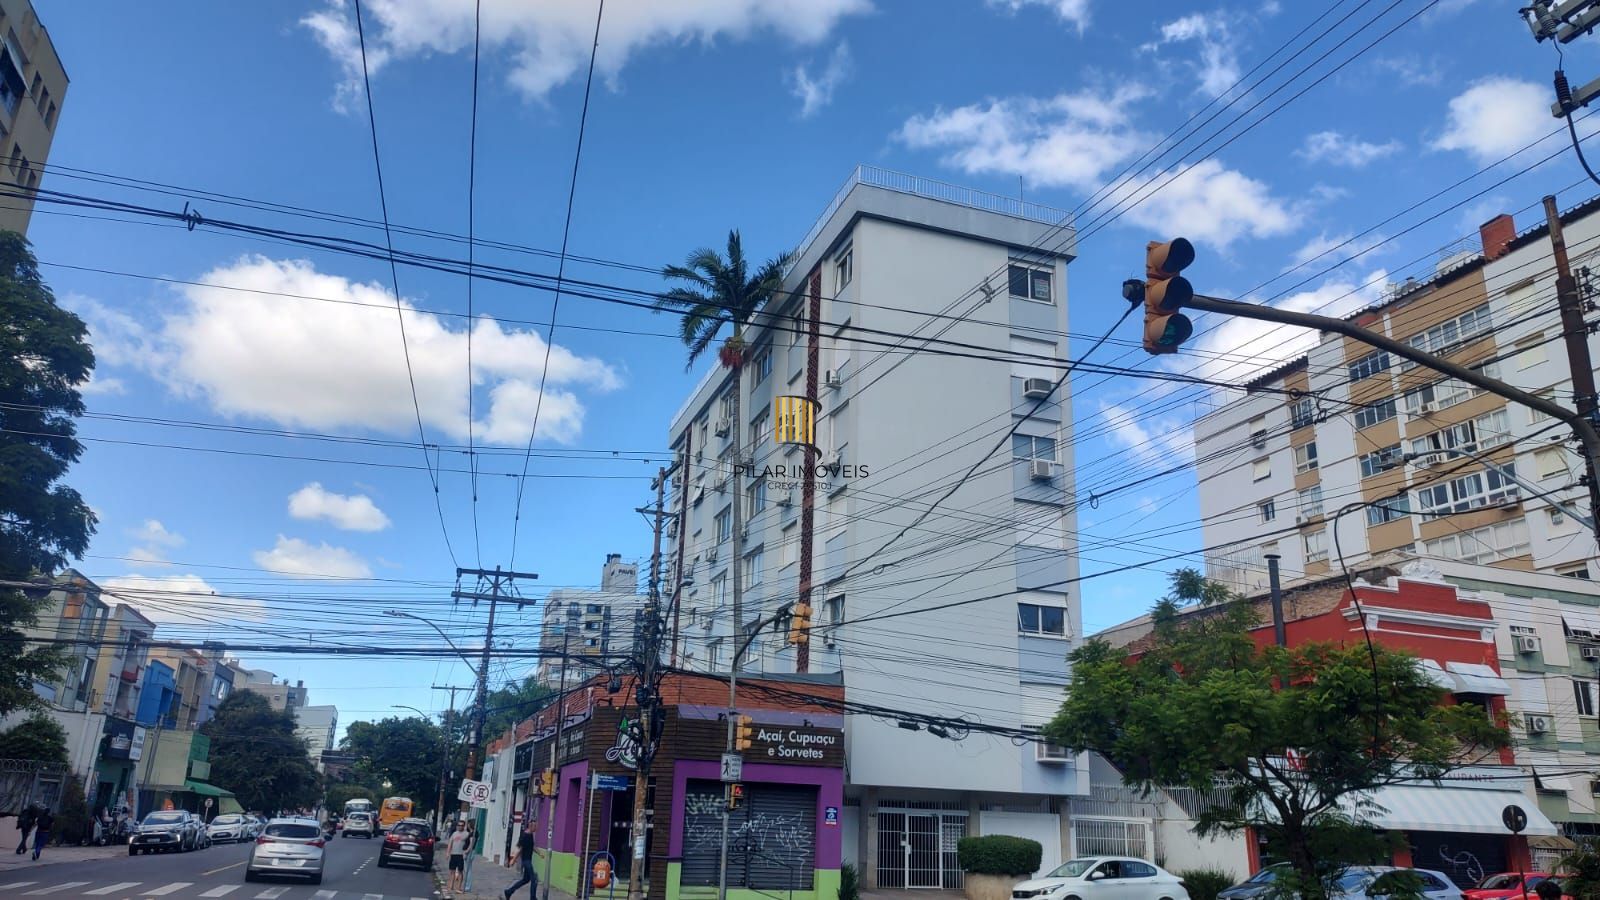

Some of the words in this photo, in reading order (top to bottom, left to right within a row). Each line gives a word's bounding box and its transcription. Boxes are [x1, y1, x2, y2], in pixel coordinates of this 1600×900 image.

[758, 729, 785, 743] Açaí,
[789, 731, 835, 746] Cupuaçu
[768, 748, 775, 756] e
[778, 745, 824, 759] Sorvetes
[466, 784, 473, 793] E
